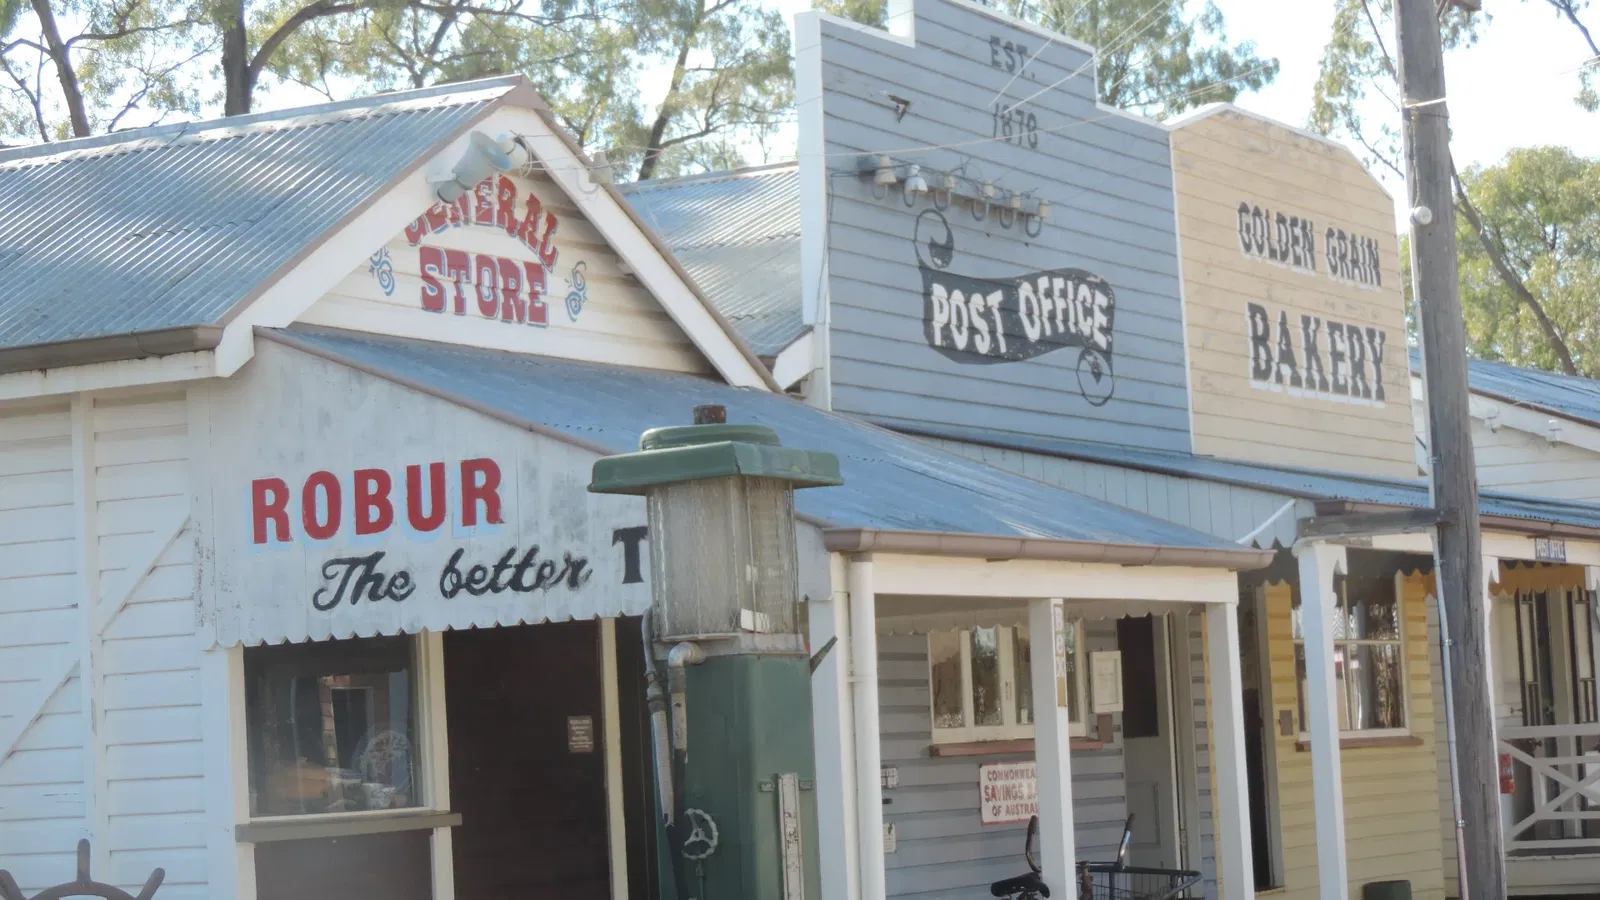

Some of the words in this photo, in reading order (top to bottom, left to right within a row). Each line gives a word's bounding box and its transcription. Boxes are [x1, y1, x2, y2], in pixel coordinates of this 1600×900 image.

[993, 101, 1038, 149] 1878
[1237, 201, 1317, 276] GOLDEN
[1324, 226, 1383, 292] GRAIN
[418, 246, 550, 329] STORE
[931, 283, 1007, 354] POST
[1017, 276, 1110, 350] OFFICE
[1247, 302, 1387, 408] BAKERY
[250, 457, 506, 547] ROBUR
[312, 550, 416, 612] The
[439, 544, 594, 600] better
[612, 525, 649, 585] T
[983, 783, 1025, 803] SAVINGS
[986, 767, 1036, 782] COMMONWEA
[991, 804, 1002, 816] OF
